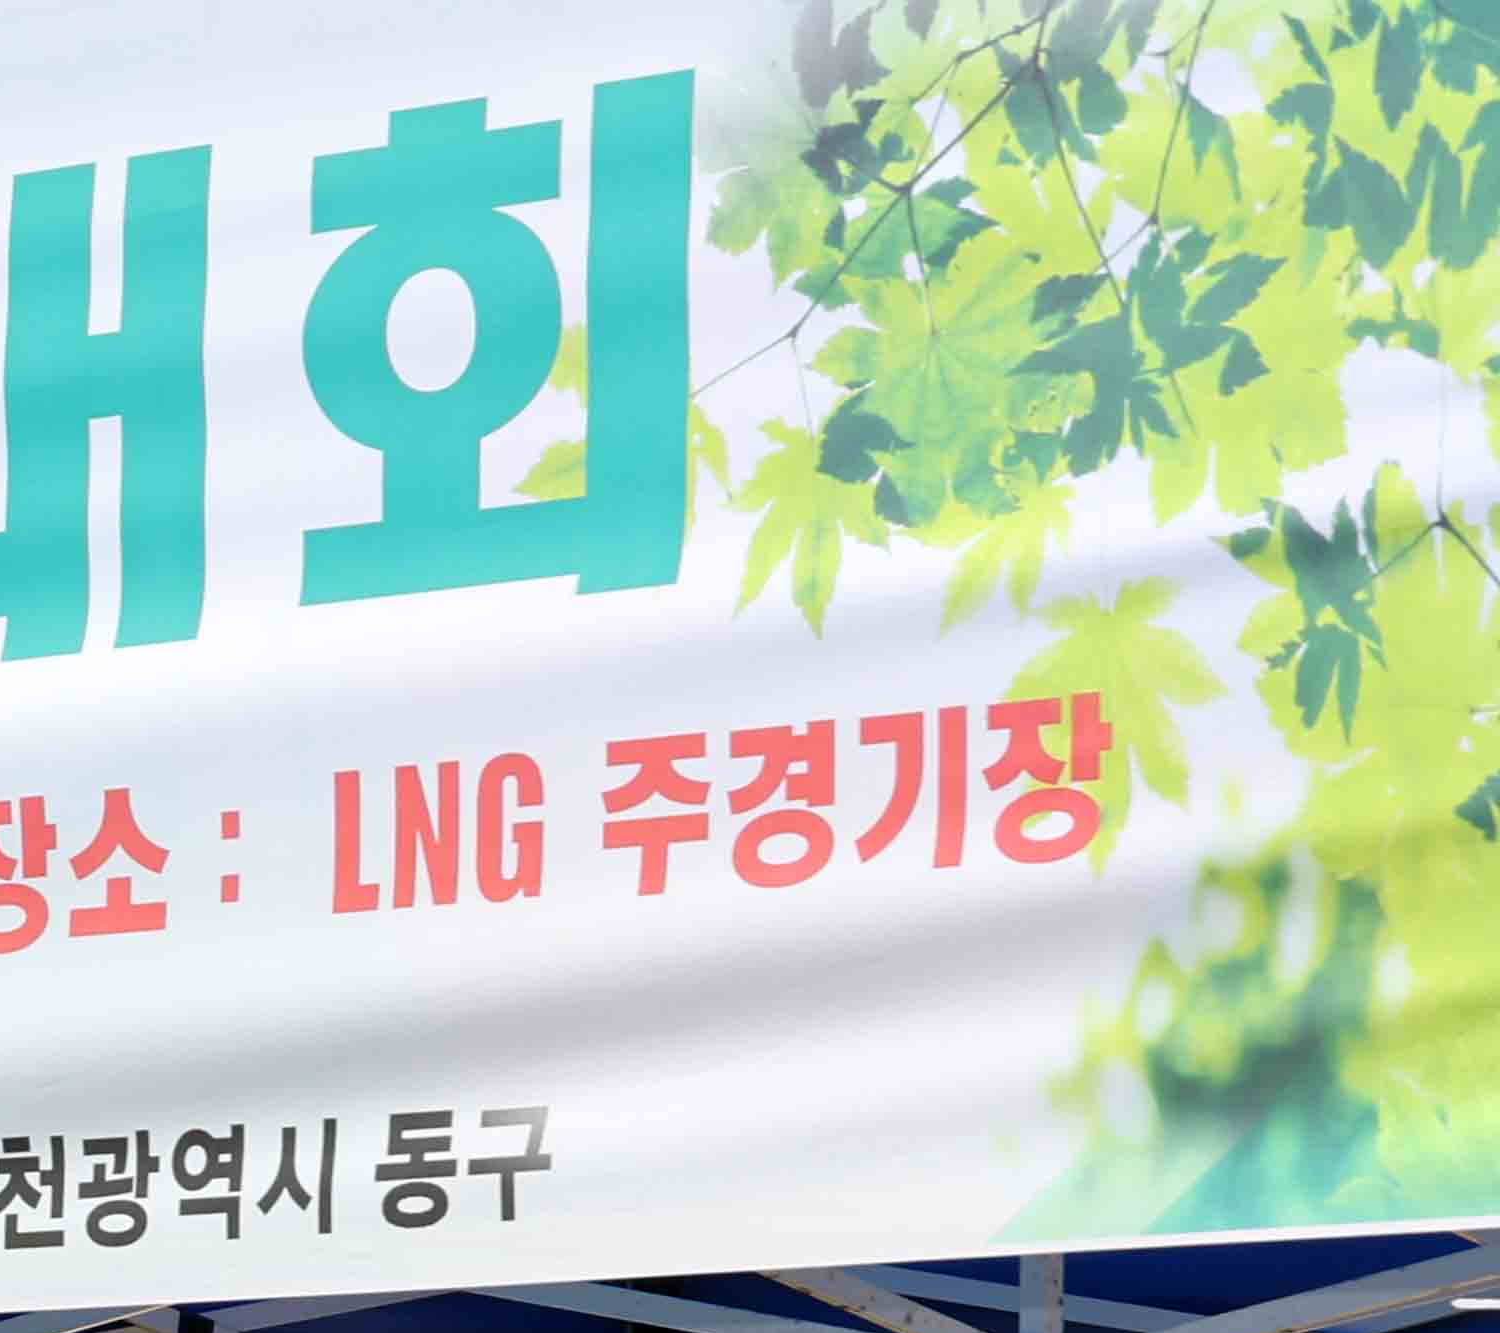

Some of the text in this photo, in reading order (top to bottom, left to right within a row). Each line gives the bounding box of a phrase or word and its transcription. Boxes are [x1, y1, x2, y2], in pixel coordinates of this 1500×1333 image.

[332, 751, 546, 914] LNG
[603, 692, 1115, 897] 주경기장
[375, 1111, 547, 1229] 동구
